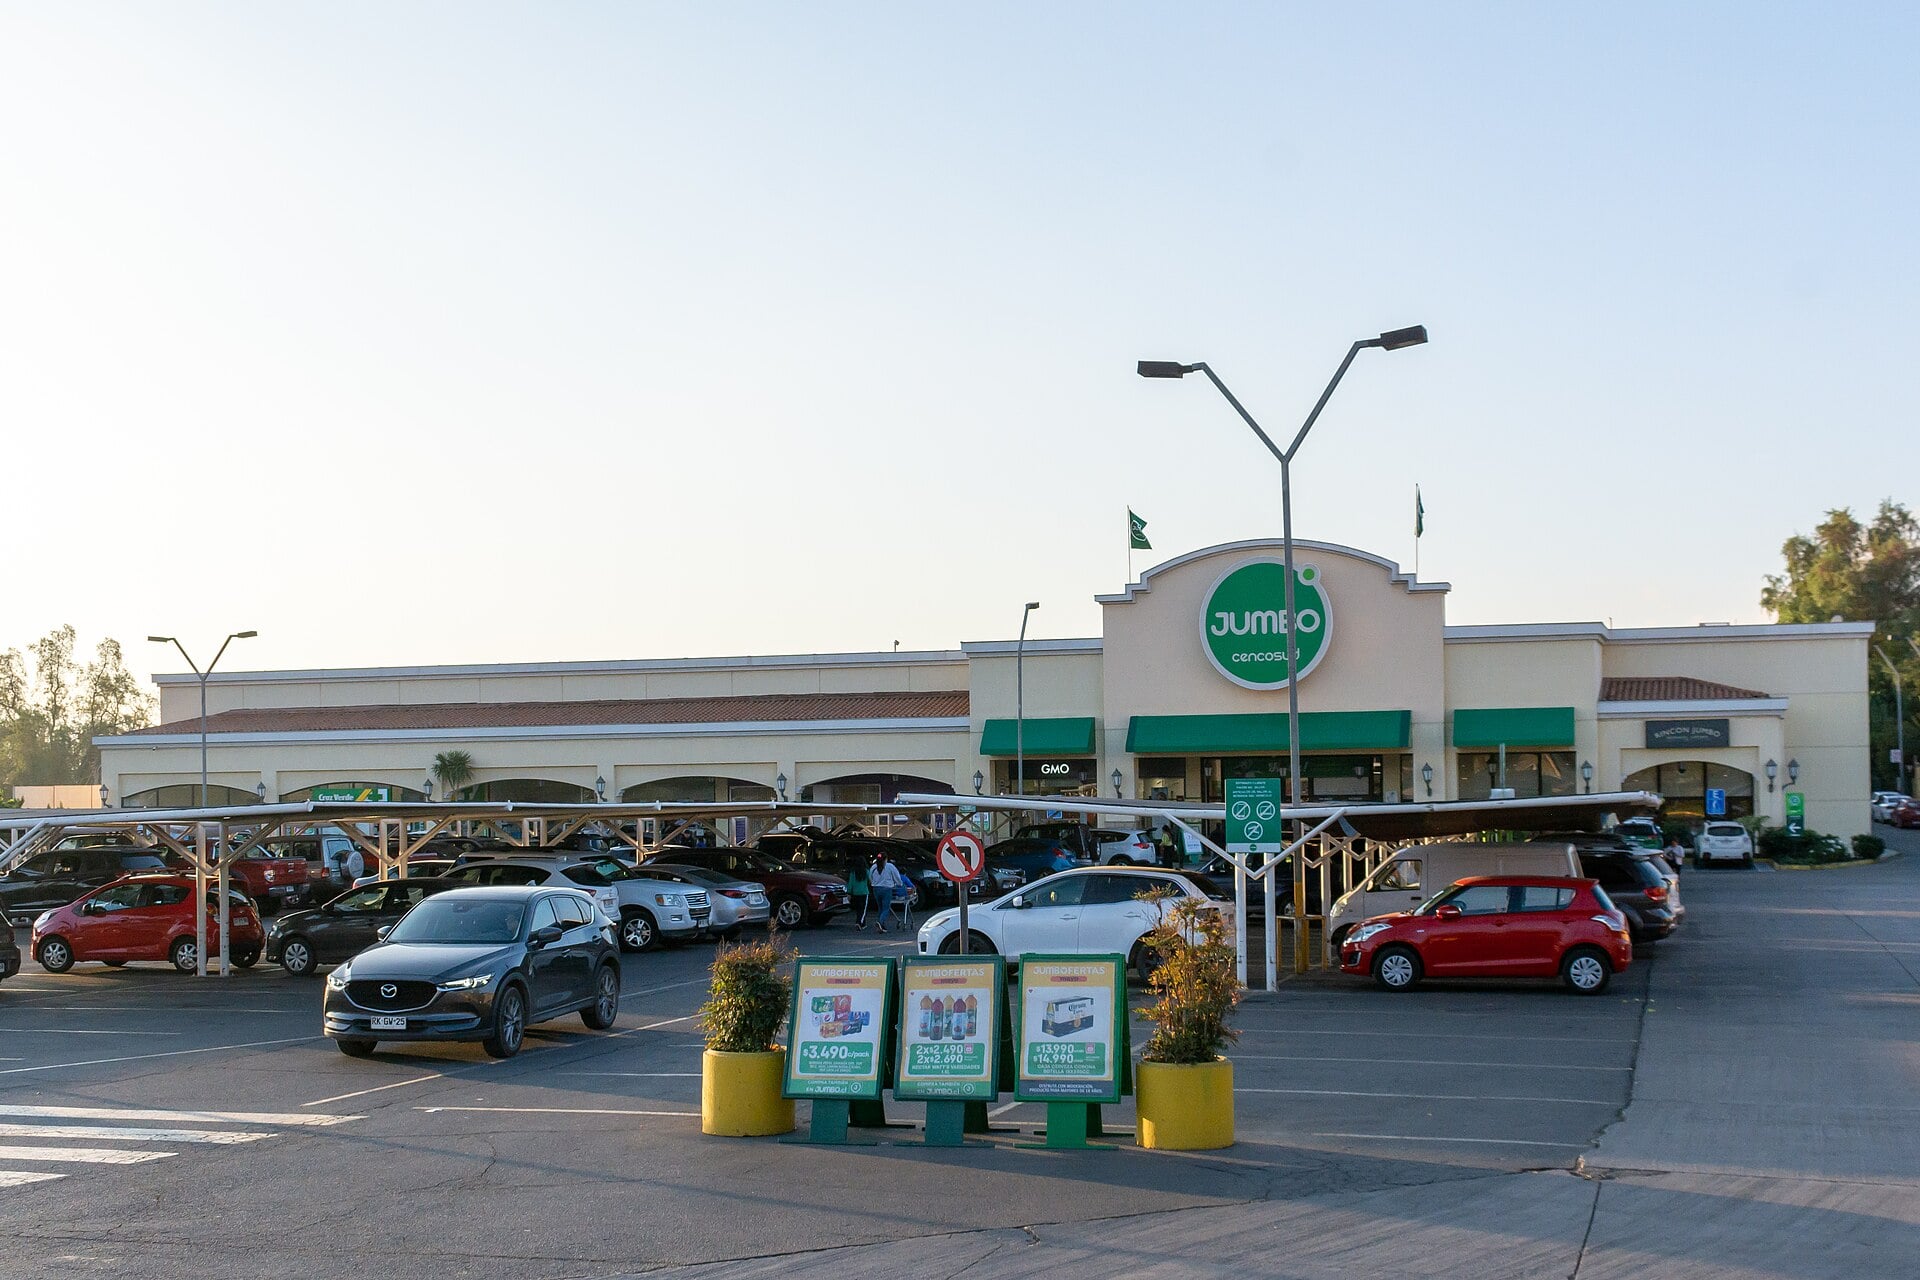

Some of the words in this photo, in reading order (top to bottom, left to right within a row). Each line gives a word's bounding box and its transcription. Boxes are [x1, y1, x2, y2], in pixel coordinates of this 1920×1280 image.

[1210, 608, 1321, 637] JUMBO
[1690, 726, 1721, 737] JUMBO
[1041, 763, 1070, 774] GMO
[318, 793, 333, 801] Cruz
[334, 793, 354, 801] Verde
[811, 968, 878, 977] JUMBOFERTAS
[915, 968, 985, 977] JUMBOFERTAS
[1033, 966, 1105, 975] JUMBOFERTAS
[803, 1045, 848, 1059] $3.490
[1036, 1044, 1074, 1054] $13.990
[1033, 1054, 1074, 1063] $14.990
